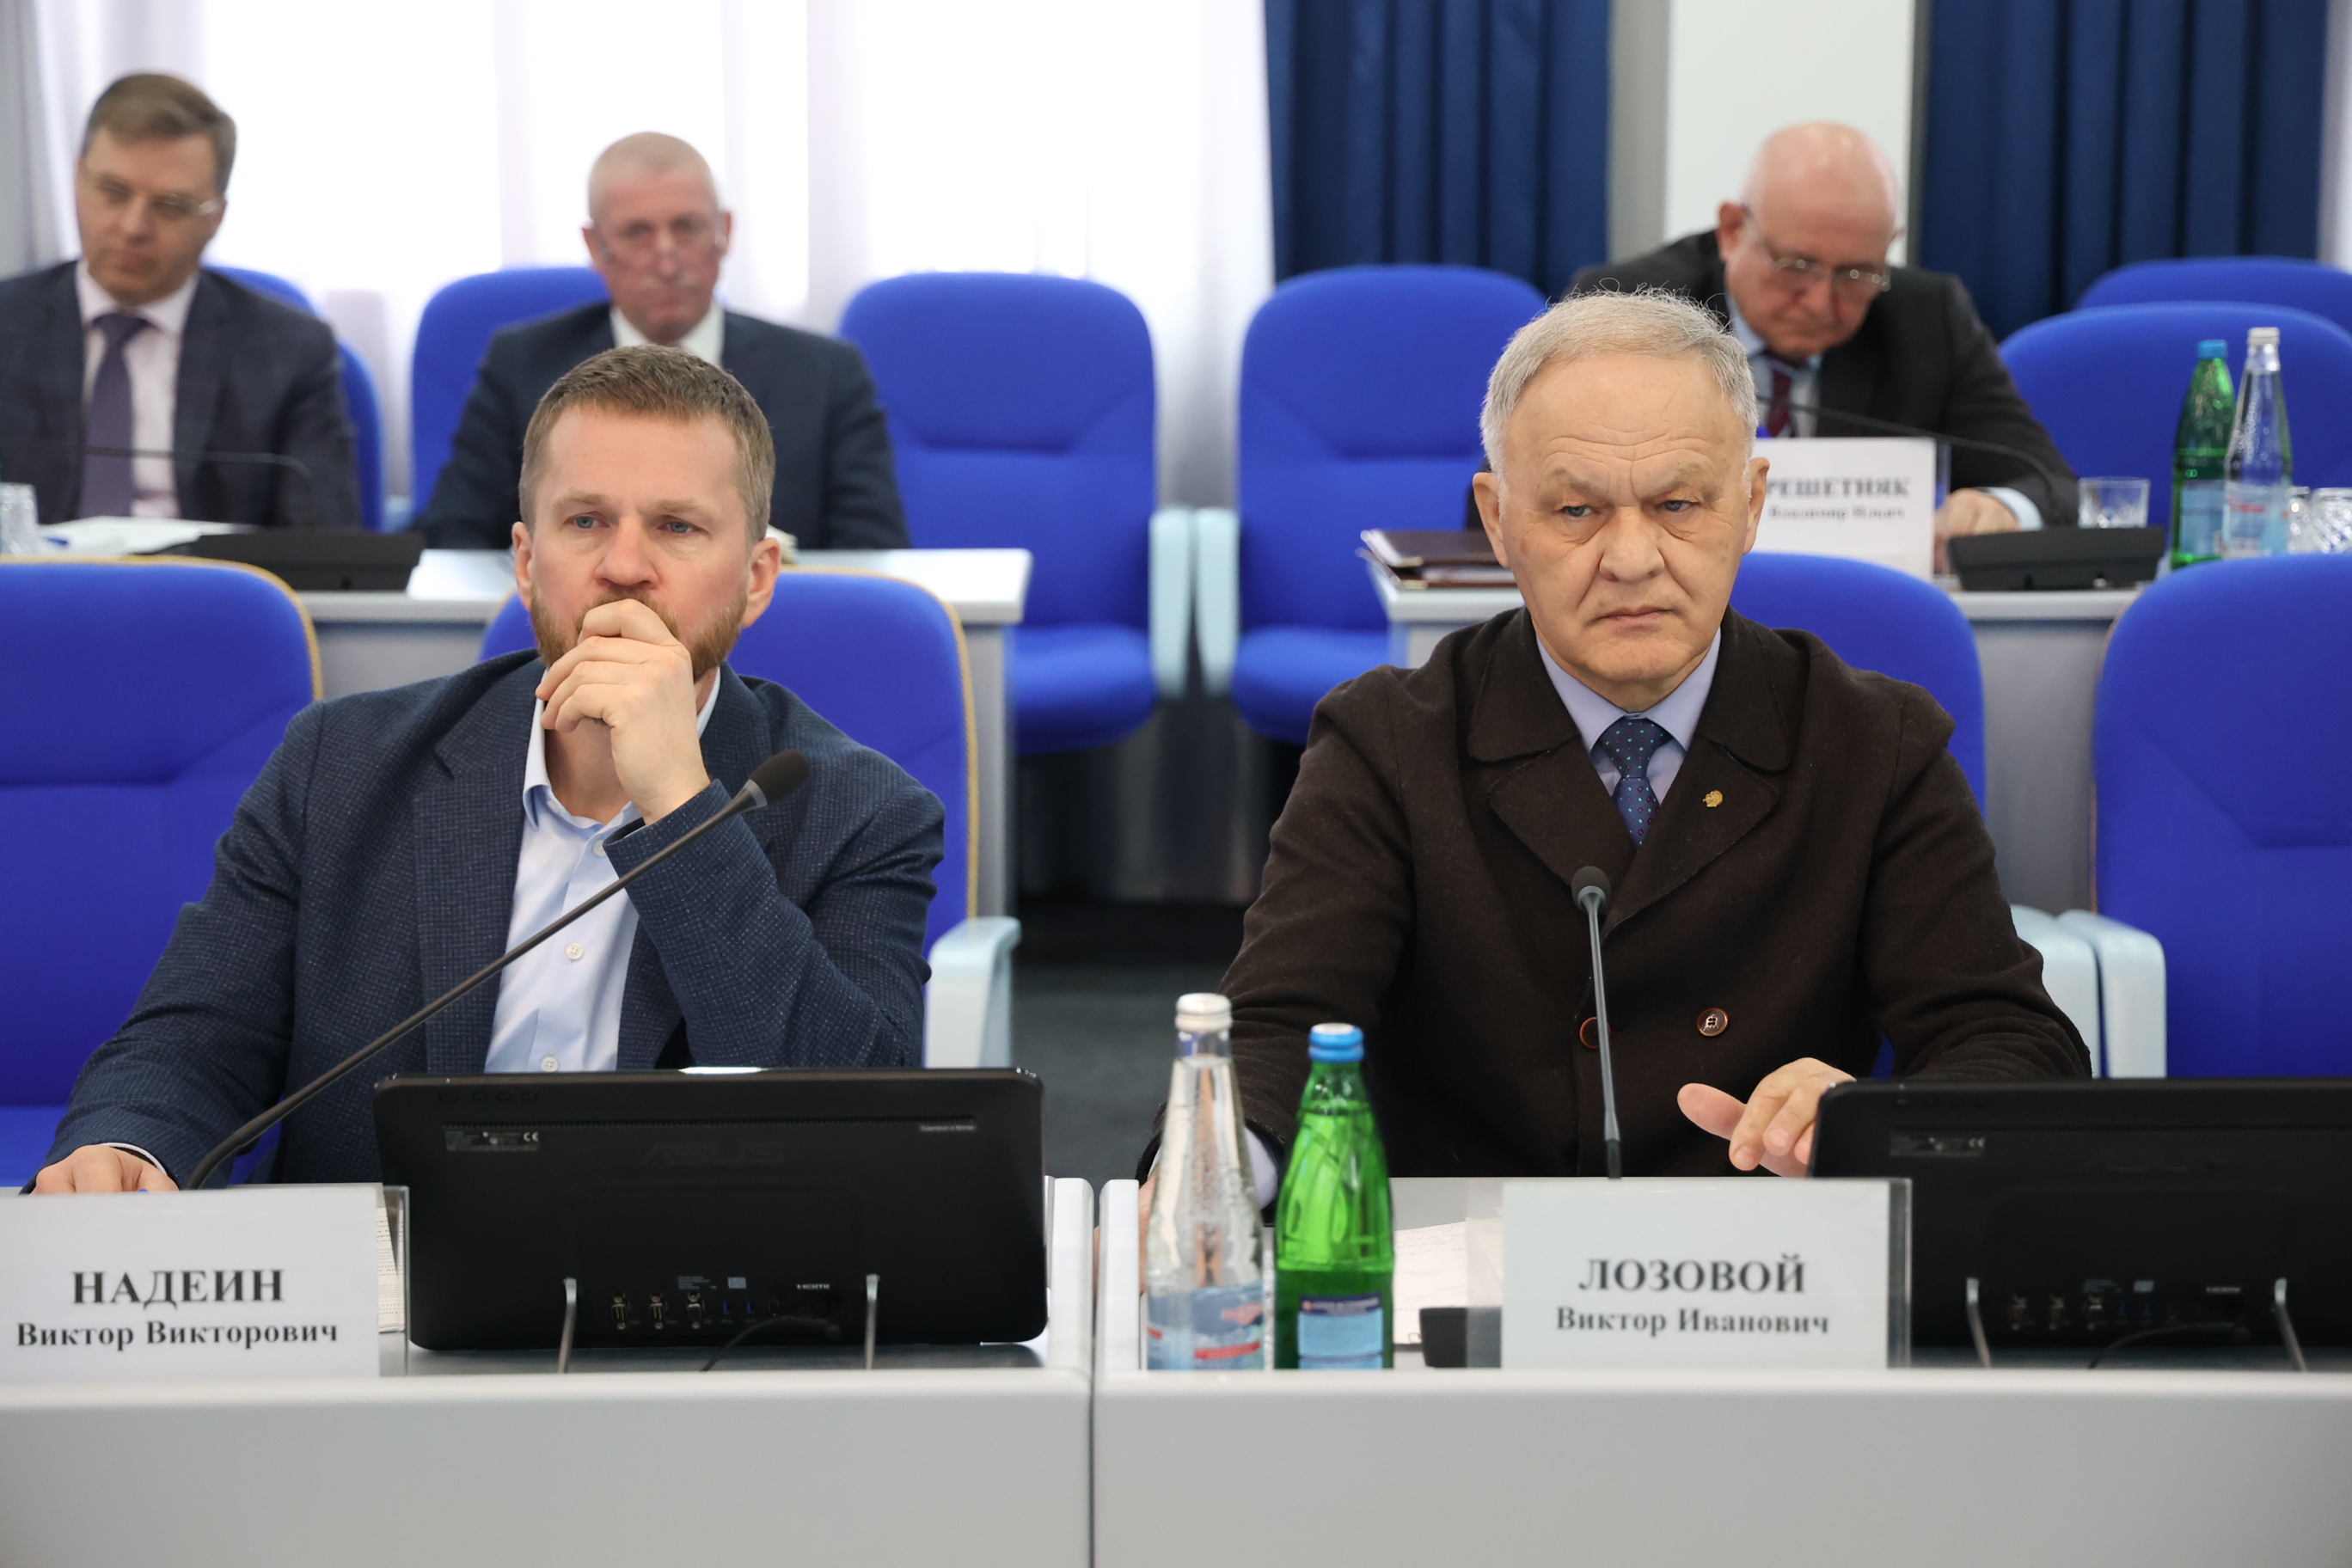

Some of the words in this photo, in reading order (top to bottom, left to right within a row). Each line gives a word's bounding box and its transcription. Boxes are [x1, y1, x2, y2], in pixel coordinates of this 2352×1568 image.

[73, 1269, 283, 1309] НАДЕИН
[1578, 1254, 1804, 1293] ЛОЗОВОЙ
[16, 1322, 134, 1351] Виктор
[146, 1320, 338, 1350] Викторович
[1556, 1306, 1667, 1338] Виктор
[1678, 1308, 1829, 1334] Иванович
